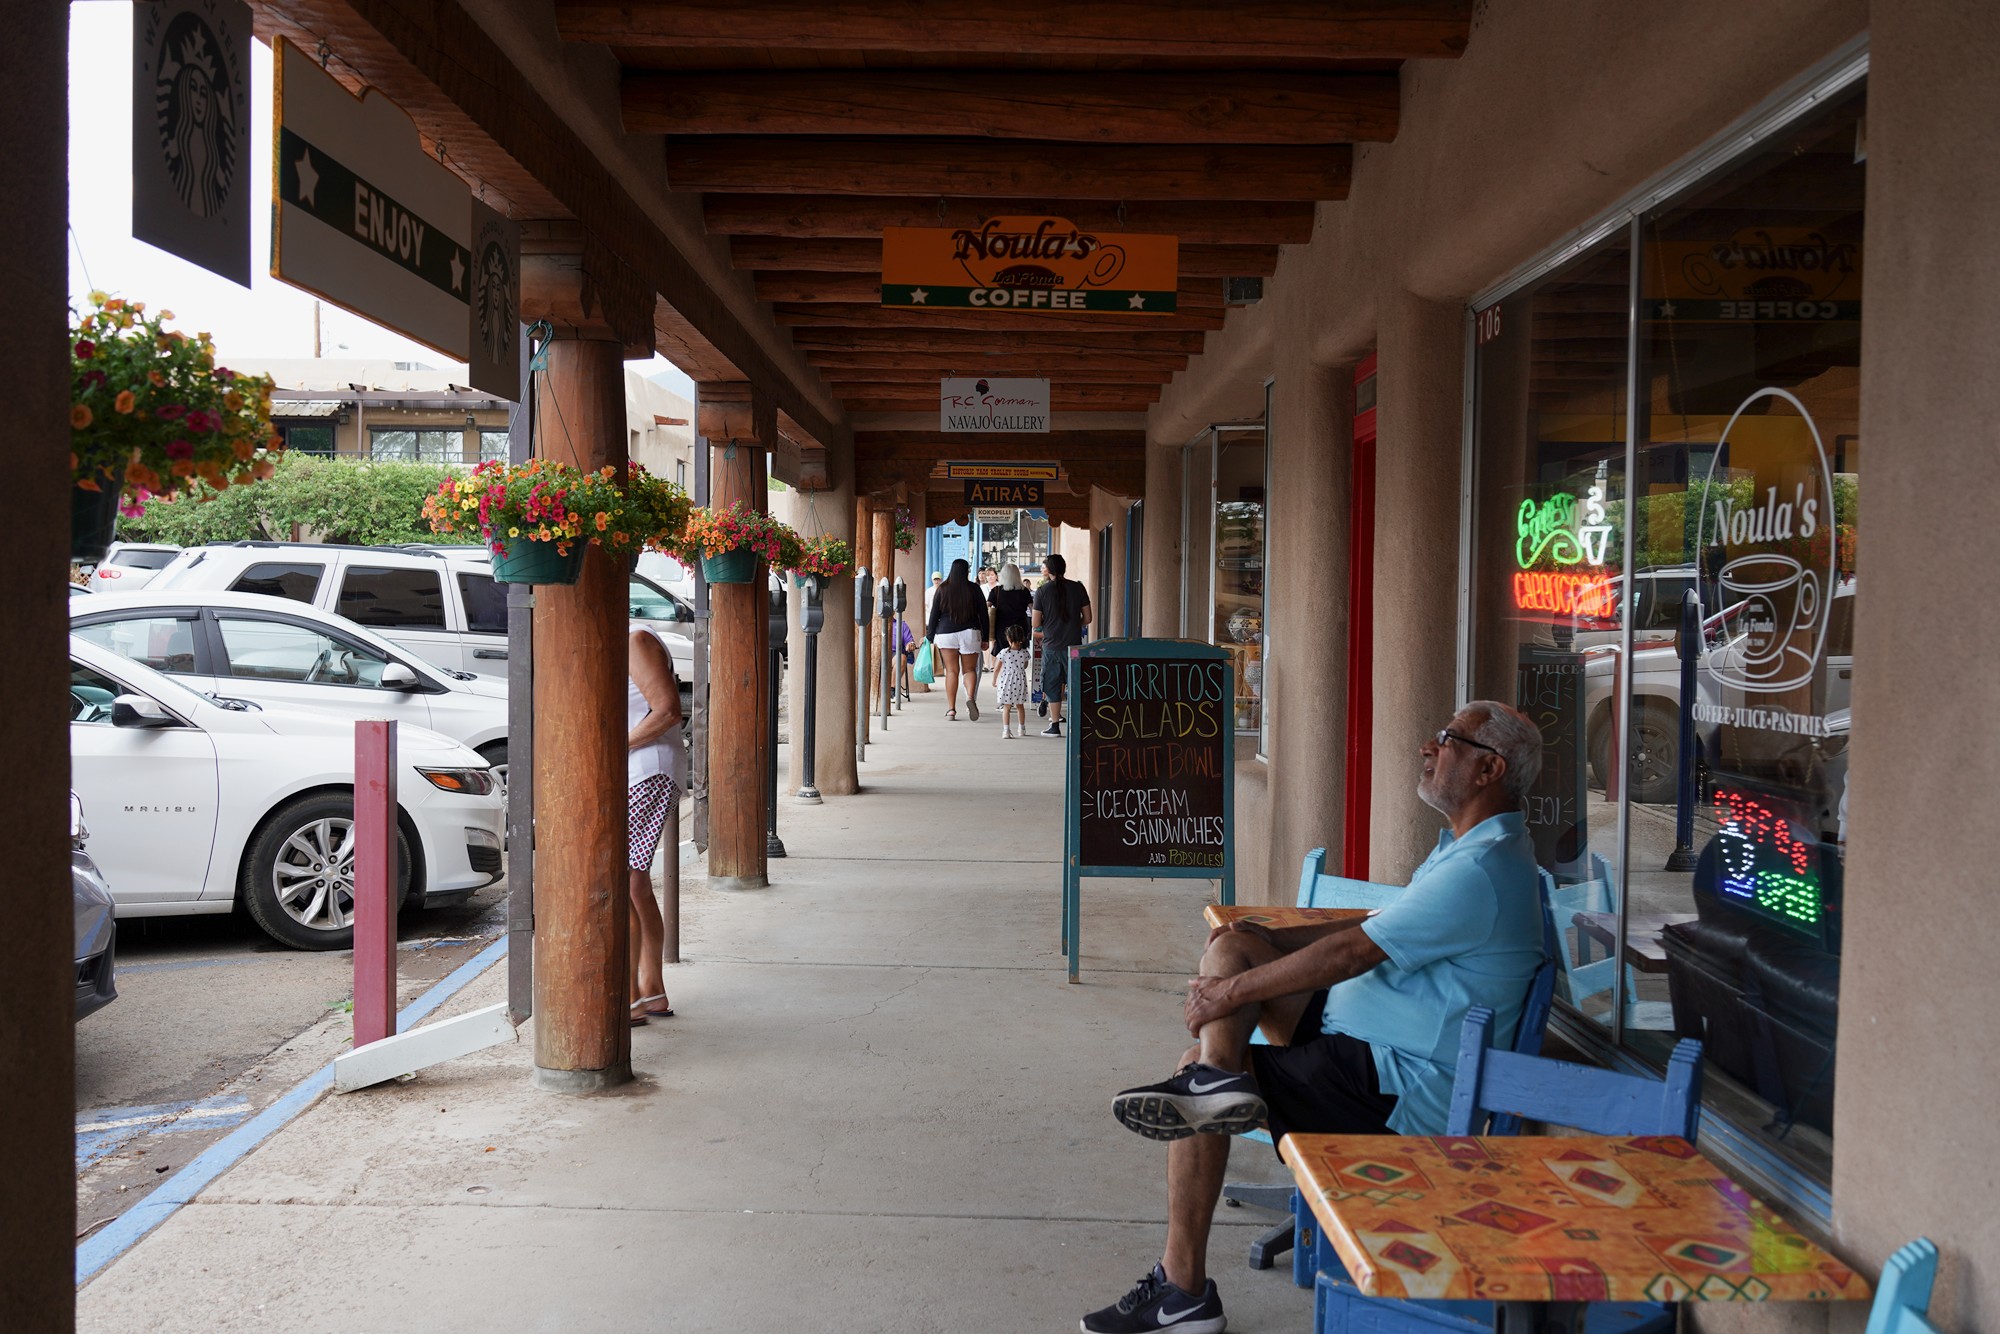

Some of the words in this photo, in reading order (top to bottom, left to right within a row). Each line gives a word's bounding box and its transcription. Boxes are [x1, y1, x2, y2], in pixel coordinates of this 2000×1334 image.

[354, 180, 425, 268] ENJOY
[951, 220, 1096, 260] Noula's
[992, 272, 1015, 285] La
[1018, 272, 1064, 286] Fonda
[968, 288, 1087, 309] COFFEE
[1478, 305, 1501, 344] 106
[948, 415, 990, 430] NAVAJO
[993, 415, 1046, 430] GALLERY
[970, 483, 1039, 503] ATIRA'S
[1710, 482, 1818, 547] Noula's
[1091, 662, 1223, 704] BURRITOS
[1539, 664, 1579, 675] JUICE
[1094, 701, 1218, 740] SALADS
[1733, 708, 1767, 729] JUICE
[1770, 711, 1831, 739] PASTRIES
[1096, 744, 1162, 787] FRUIT
[1166, 742, 1222, 779] BOWL
[124, 805, 196, 813] MALIBU
[1097, 788, 1190, 819] ICECREAM
[1122, 816, 1224, 847] SANDWICHES
[1148, 853, 1167, 864] AND
